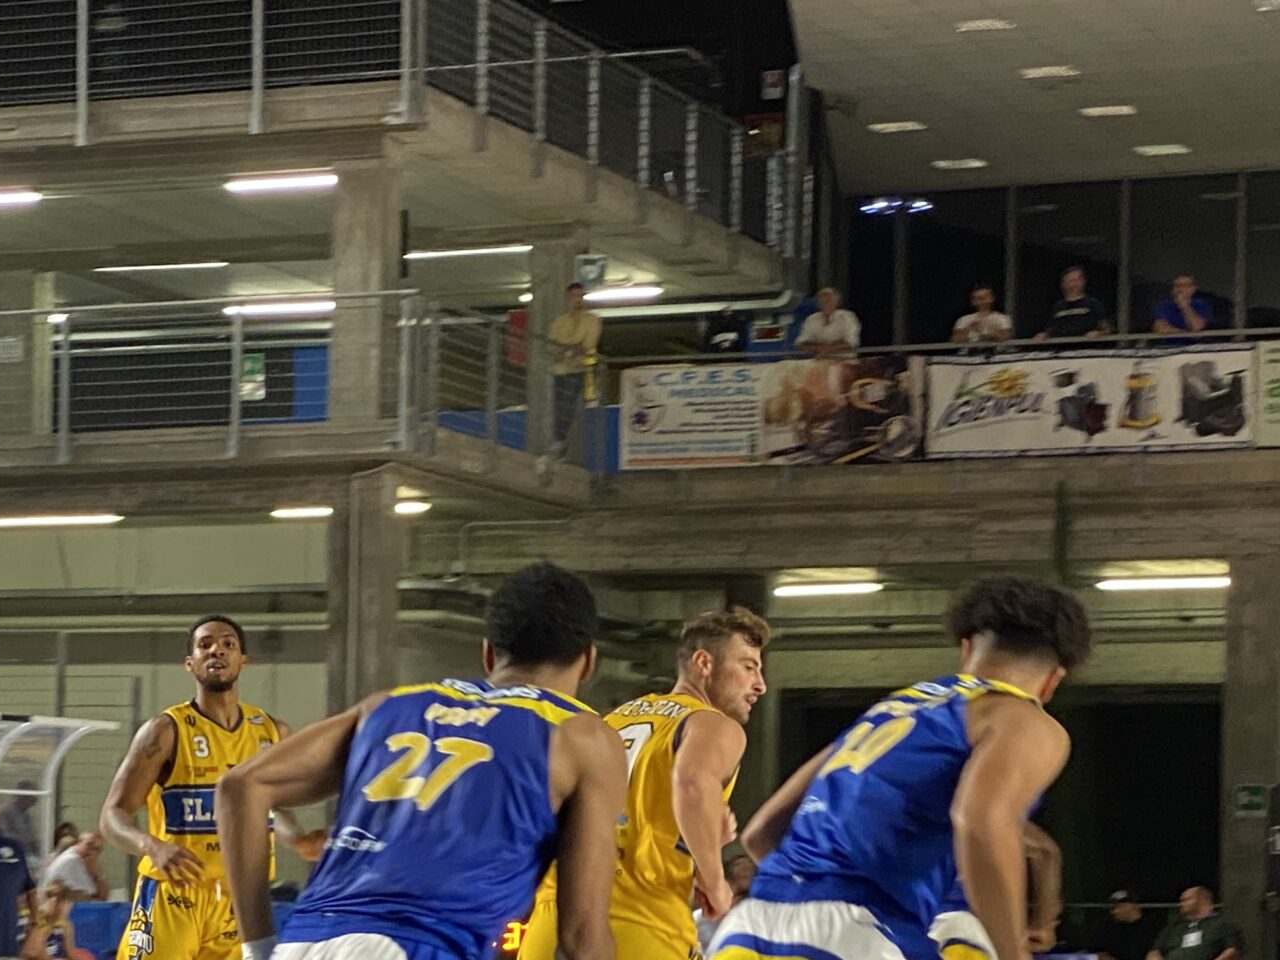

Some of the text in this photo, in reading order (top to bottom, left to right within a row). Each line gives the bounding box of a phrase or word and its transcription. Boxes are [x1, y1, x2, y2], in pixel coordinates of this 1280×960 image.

[193, 735, 211, 759] 3
[361, 731, 495, 812] 27
[502, 921, 529, 950] 3
